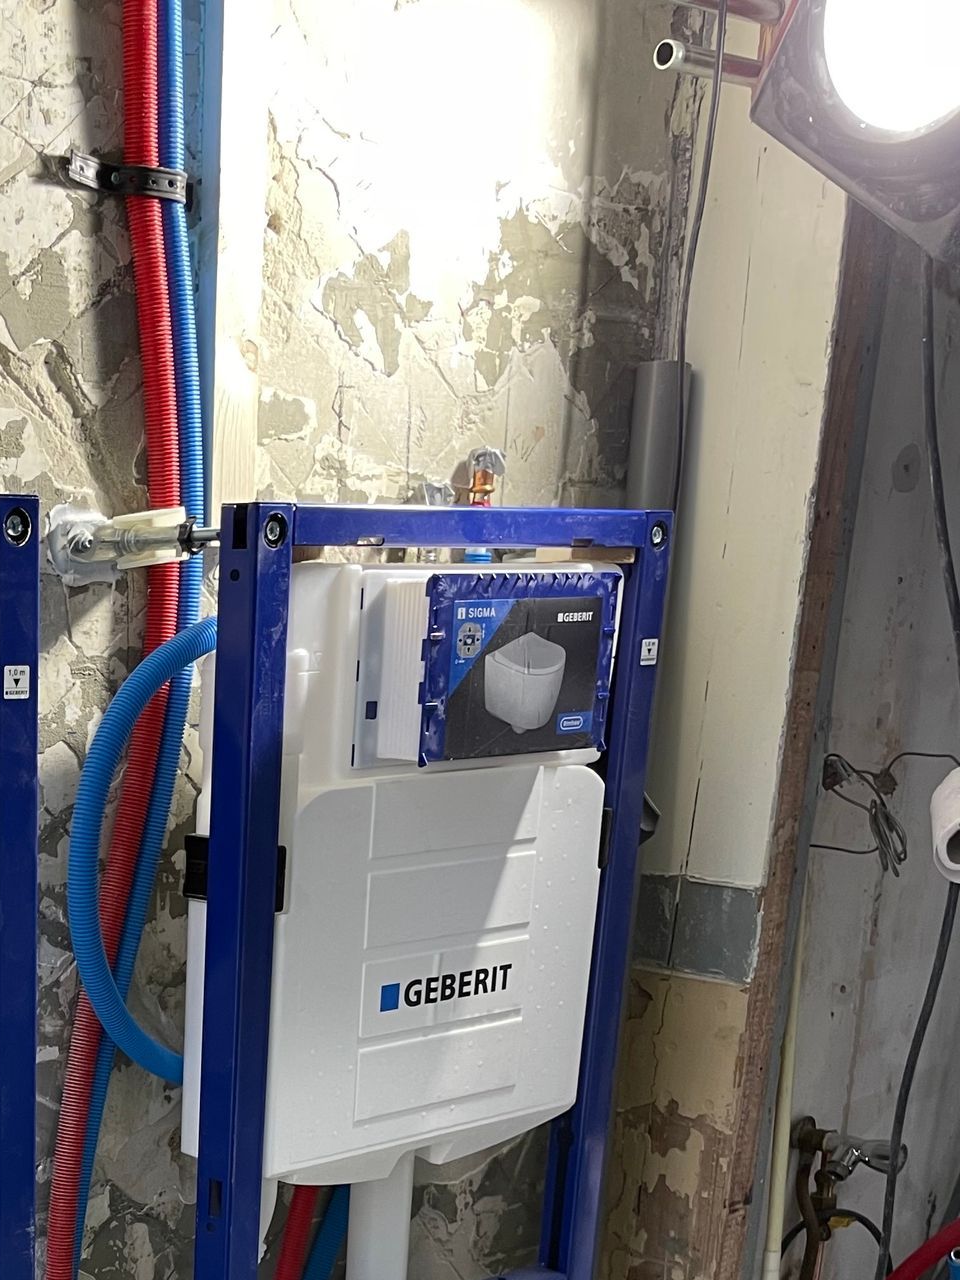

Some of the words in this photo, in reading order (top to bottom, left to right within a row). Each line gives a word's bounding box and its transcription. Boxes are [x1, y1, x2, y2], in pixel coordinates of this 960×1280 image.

[468, 607, 496, 619] SIGMA
[563, 612, 594, 622] GEBERIT
[403, 963, 513, 1008] GEBERIT
